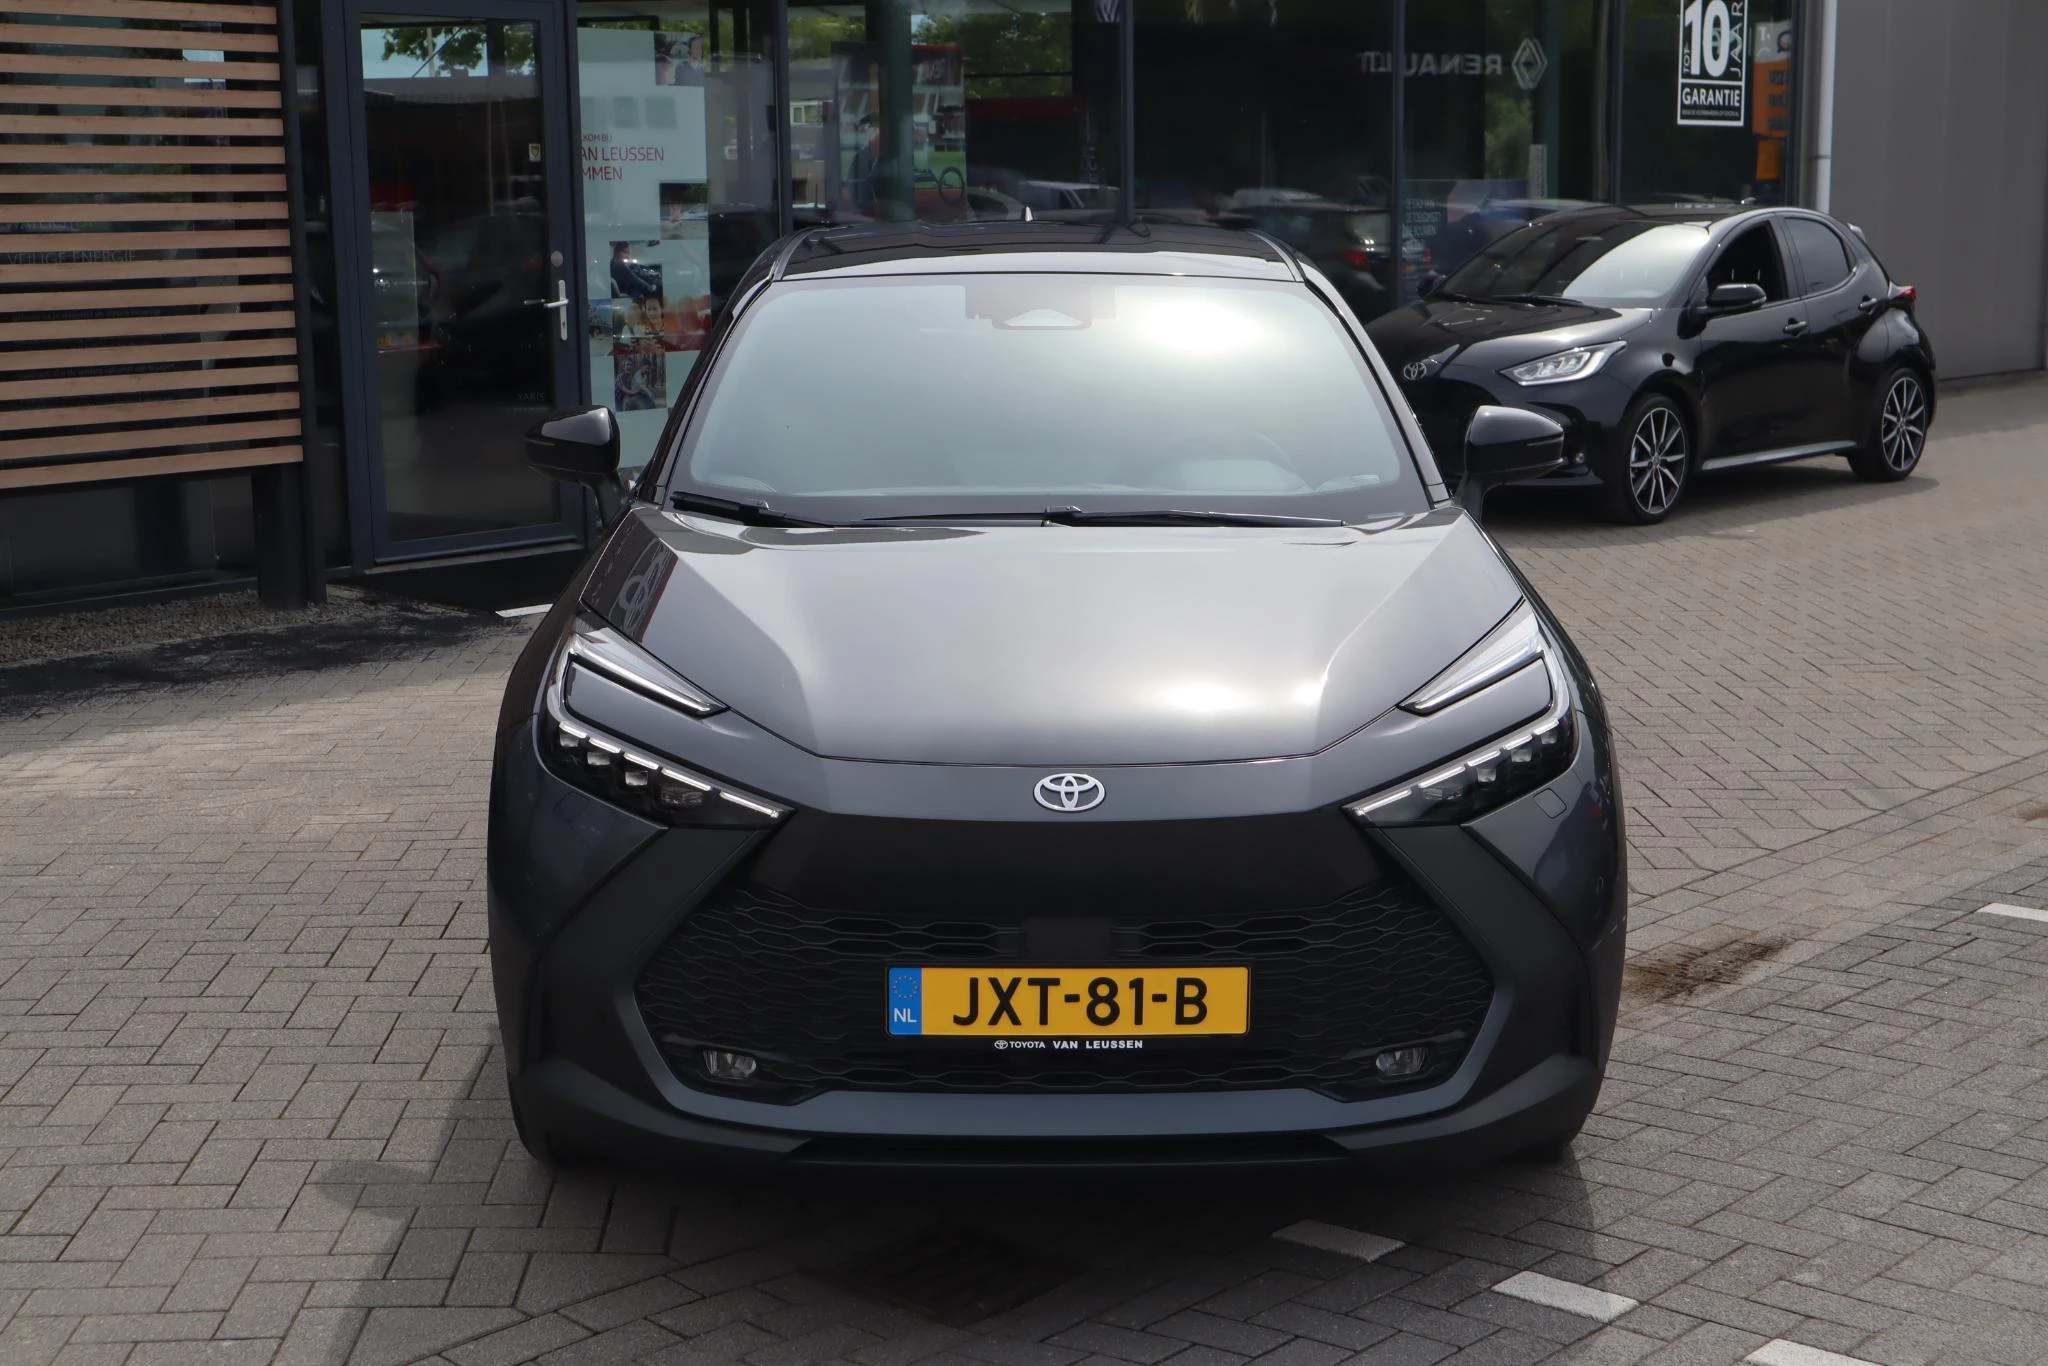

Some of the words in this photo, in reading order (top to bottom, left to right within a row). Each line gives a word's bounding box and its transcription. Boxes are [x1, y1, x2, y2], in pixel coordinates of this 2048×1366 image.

[1684, 0, 1730, 77] 10
[1730, 1, 1743, 78] JAAR
[1683, 48, 1691, 73] TOT
[1681, 87, 1740, 107] GARANTIE
[582, 133, 600, 142] KOM
[580, 147, 598, 161] AN
[602, 147, 664, 161] LEUSSEN
[582, 166, 623, 181] MMEN
[953, 977, 1208, 1026] JXT-81-B
[894, 1008, 917, 1023] NL
[1009, 1041, 1046, 1049] TOYOTA
[1053, 1040, 1079, 1049] VAN
[1086, 1040, 1143, 1049] LEUSSEN
